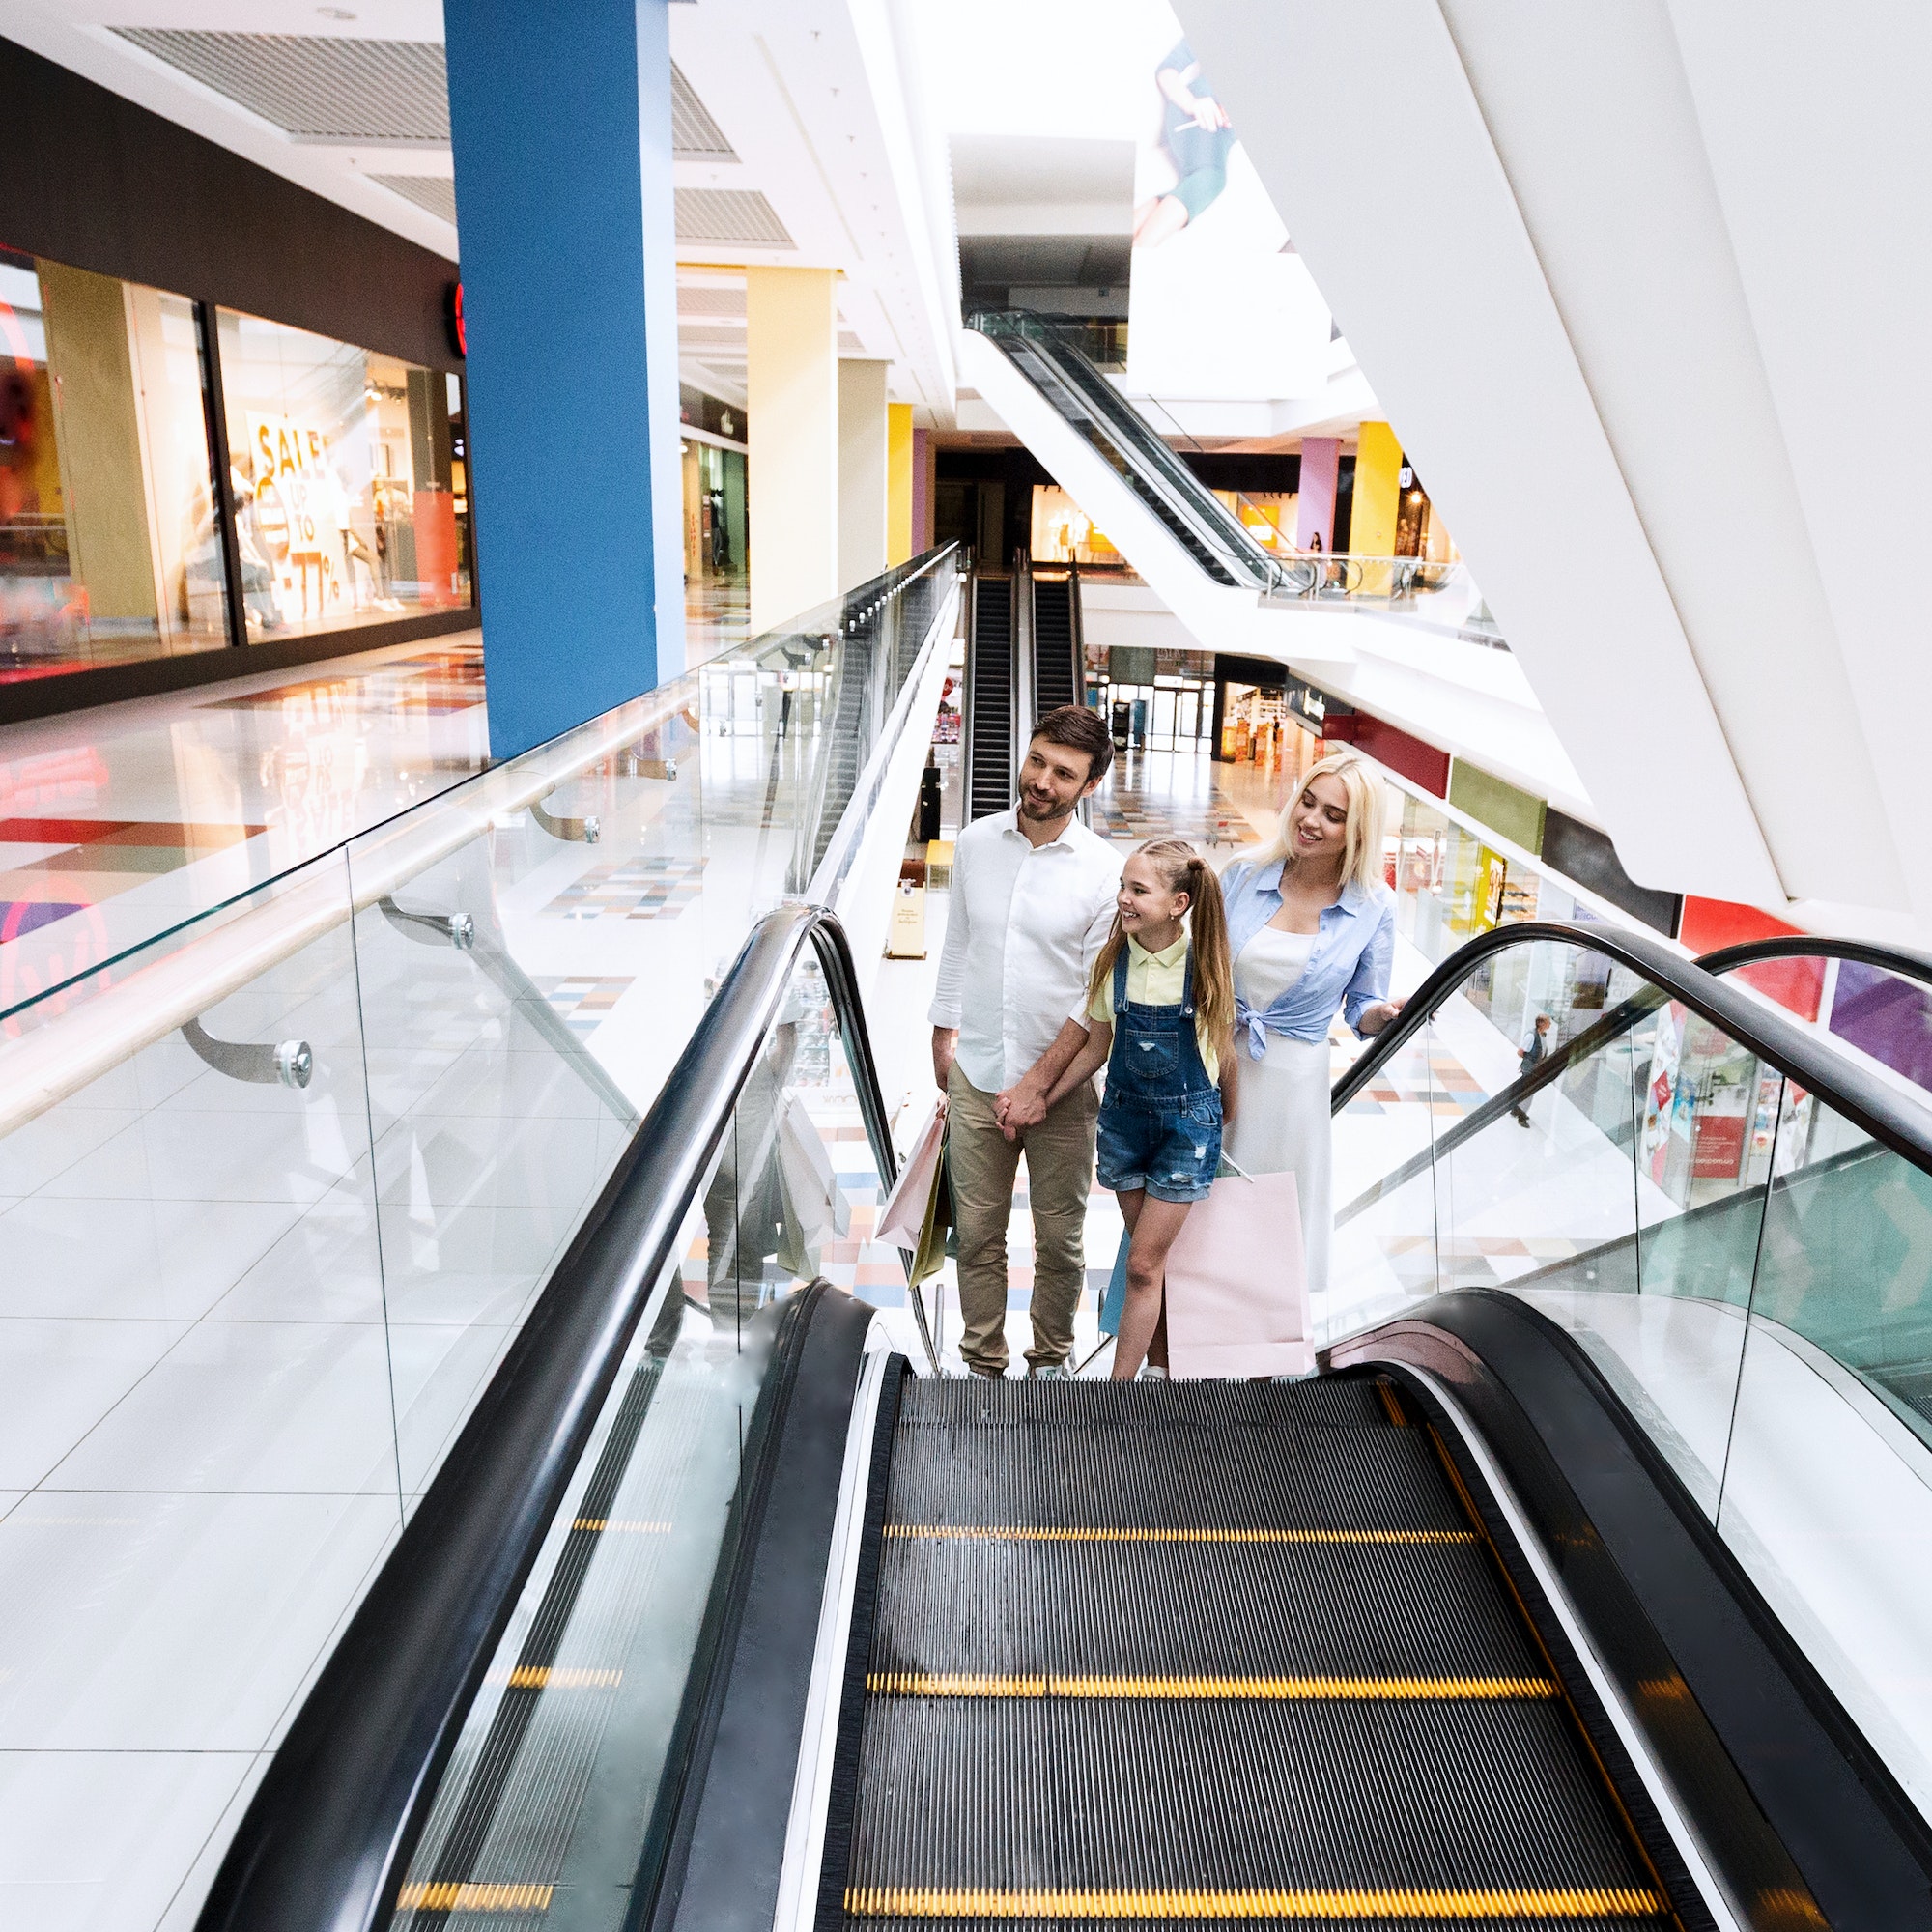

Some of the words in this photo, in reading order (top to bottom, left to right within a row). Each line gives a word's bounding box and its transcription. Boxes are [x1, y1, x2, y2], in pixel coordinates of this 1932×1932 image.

[259, 425, 324, 480] SALE
[291, 482, 308, 510] UP
[295, 514, 314, 543] TO
